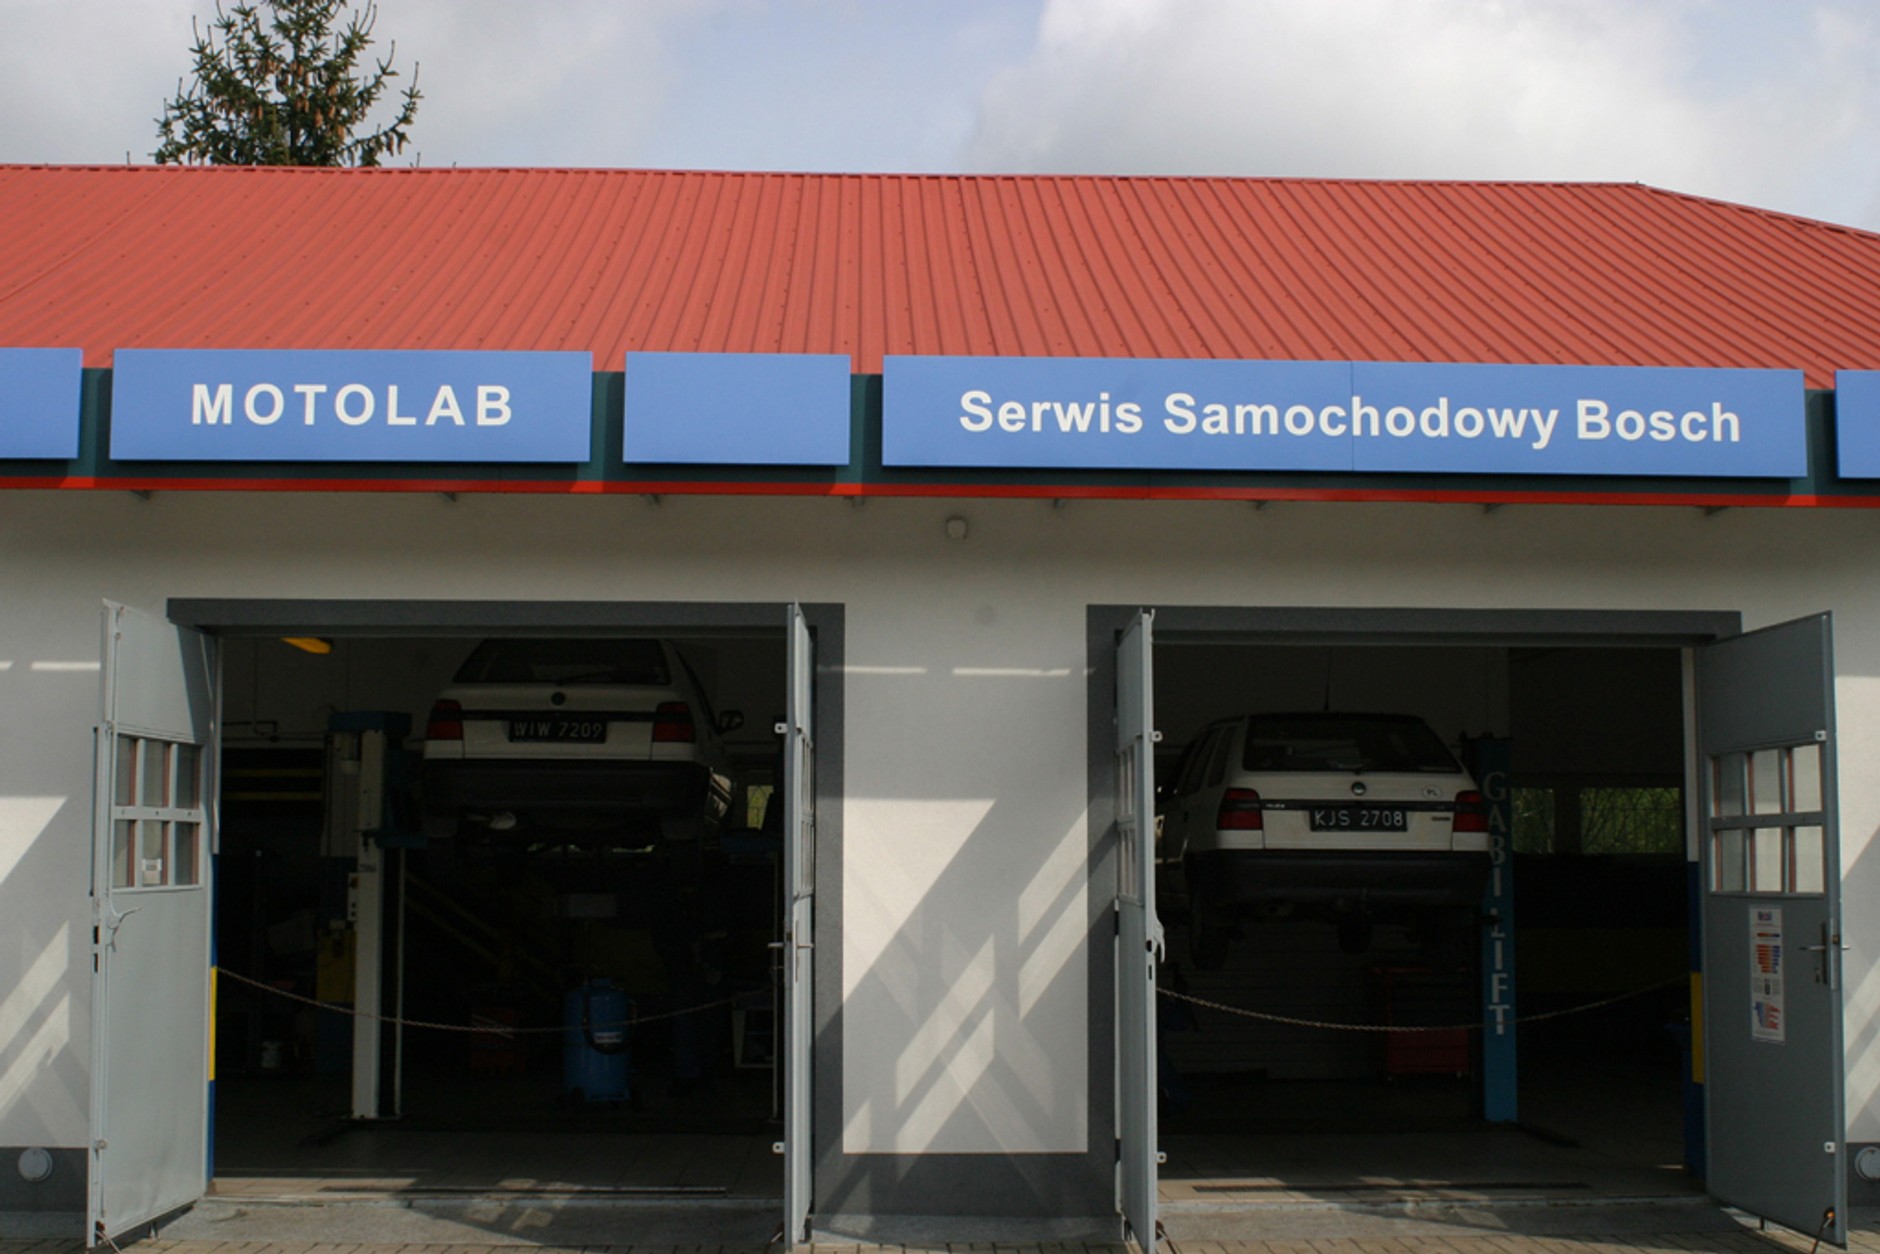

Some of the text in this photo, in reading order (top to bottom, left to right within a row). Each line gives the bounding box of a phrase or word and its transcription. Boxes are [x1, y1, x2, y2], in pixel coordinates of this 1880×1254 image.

[192, 383, 512, 427] MOTOLAB
[959, 391, 1740, 450] Serwis Samochodowy Bosch
[558, 721, 604, 739] 7209
[1314, 811, 1404, 828] KJS 2708
